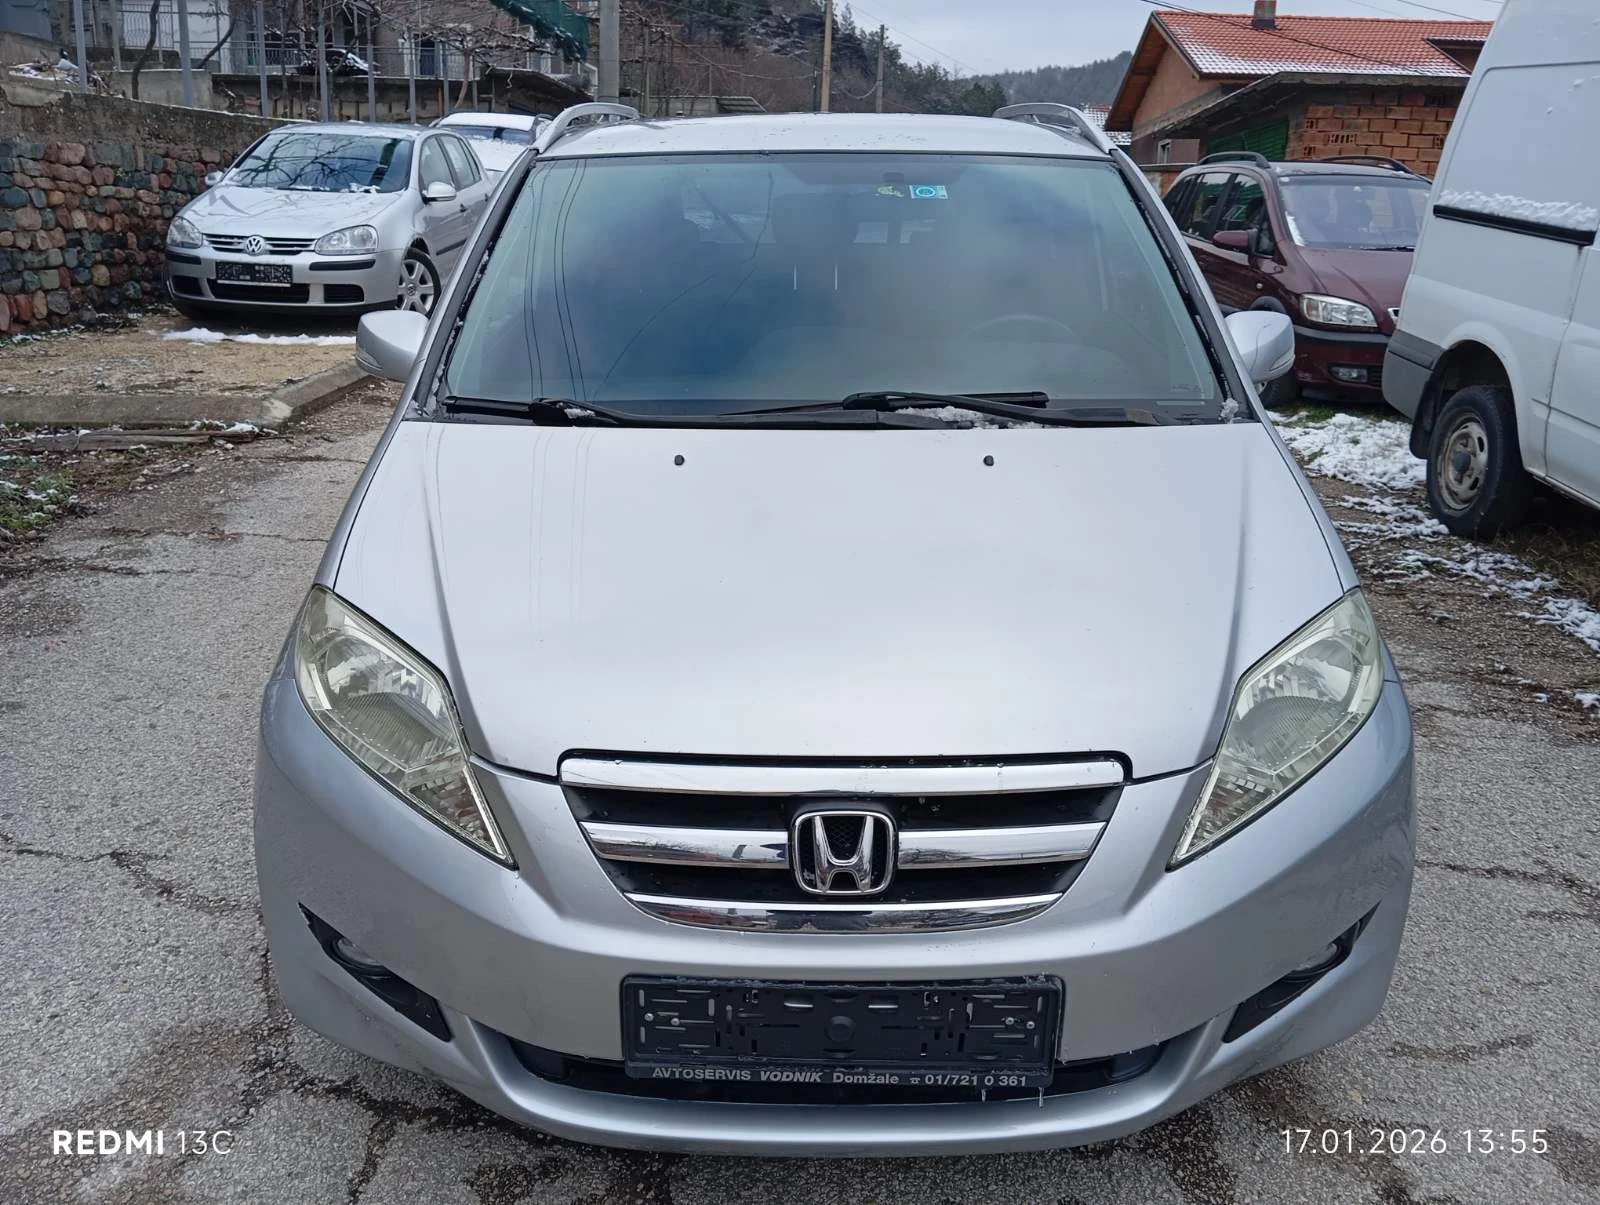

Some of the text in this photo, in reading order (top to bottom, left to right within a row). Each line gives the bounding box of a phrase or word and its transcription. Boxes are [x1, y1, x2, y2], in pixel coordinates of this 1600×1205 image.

[652, 1067, 1027, 1087] AVTOSERVIS VODNIK Domžale 01/721 0 361
